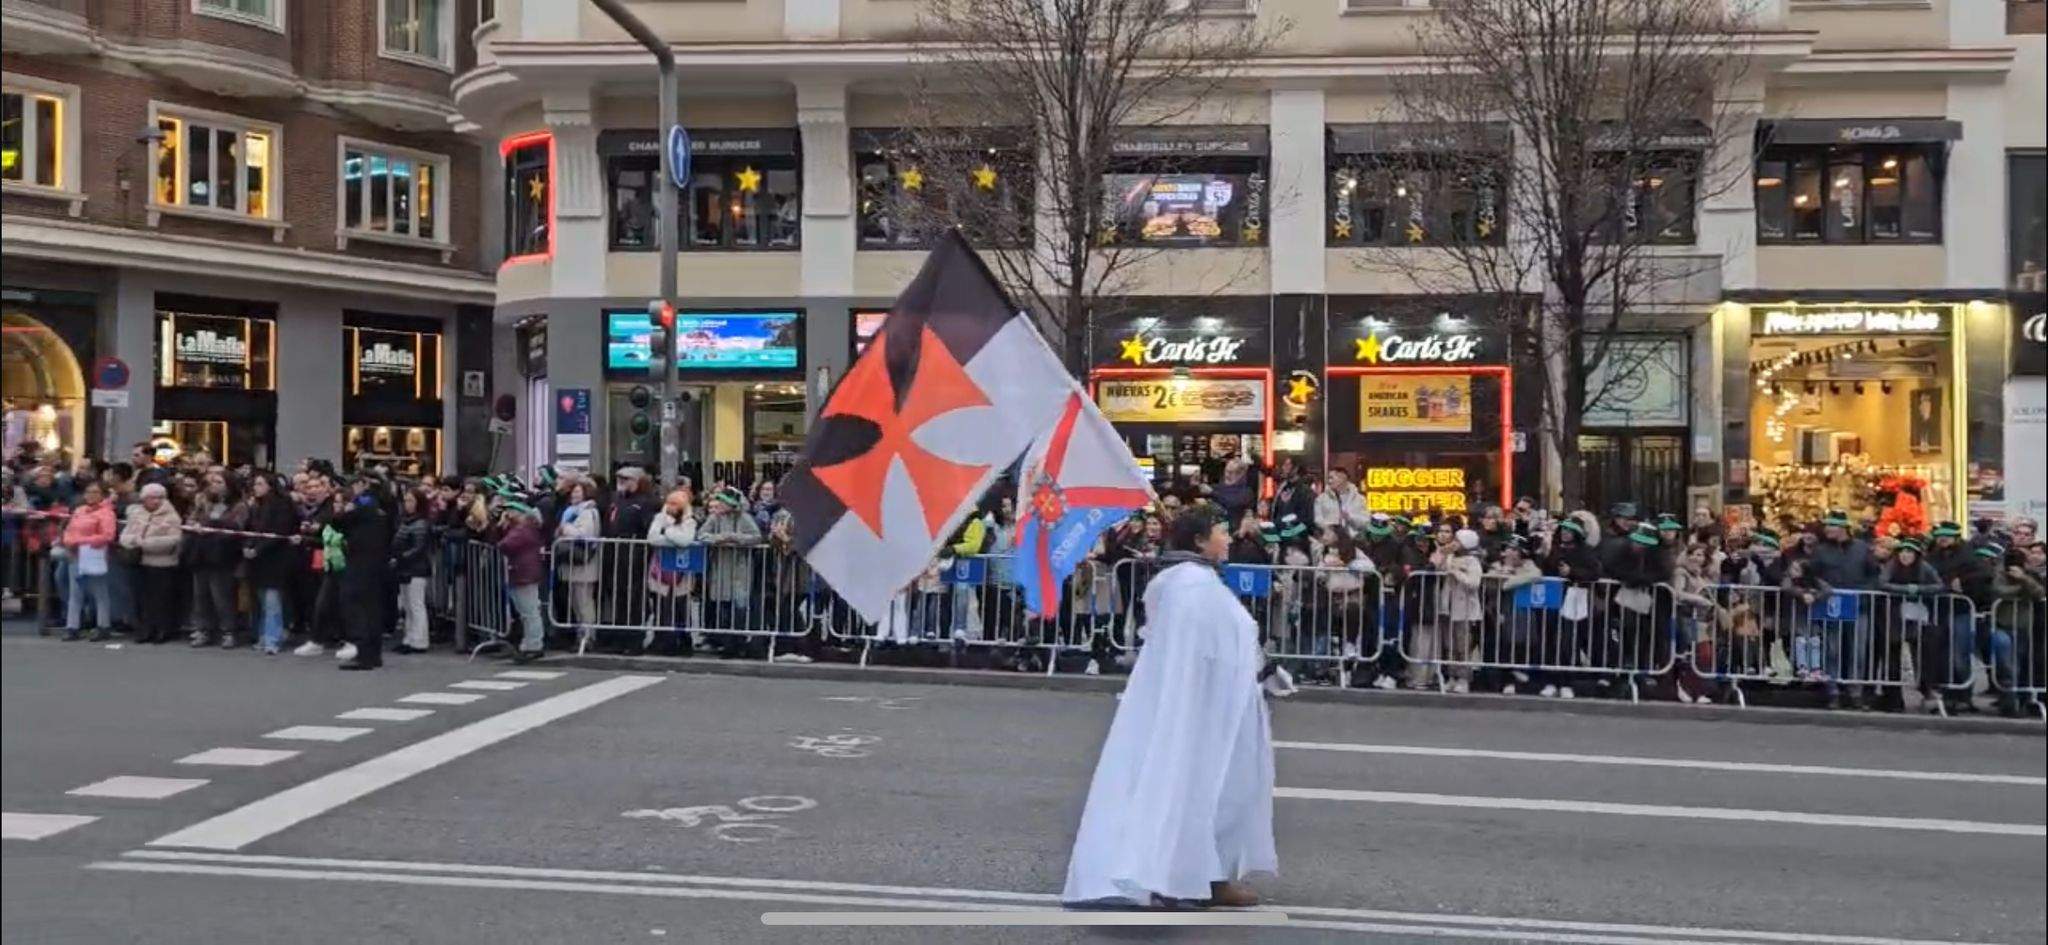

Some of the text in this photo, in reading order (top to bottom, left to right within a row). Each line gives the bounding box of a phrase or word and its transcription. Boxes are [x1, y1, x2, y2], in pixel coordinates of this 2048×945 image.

[1143, 336, 1239, 364] Carl's Jr.
[1379, 334, 1476, 362] Carl's Jr.
[1106, 384, 1150, 397] NUEVAS
[1368, 406, 1409, 417] SHAKES
[1367, 468, 1465, 488] BIGGER
[1367, 491, 1467, 511] BETTER
